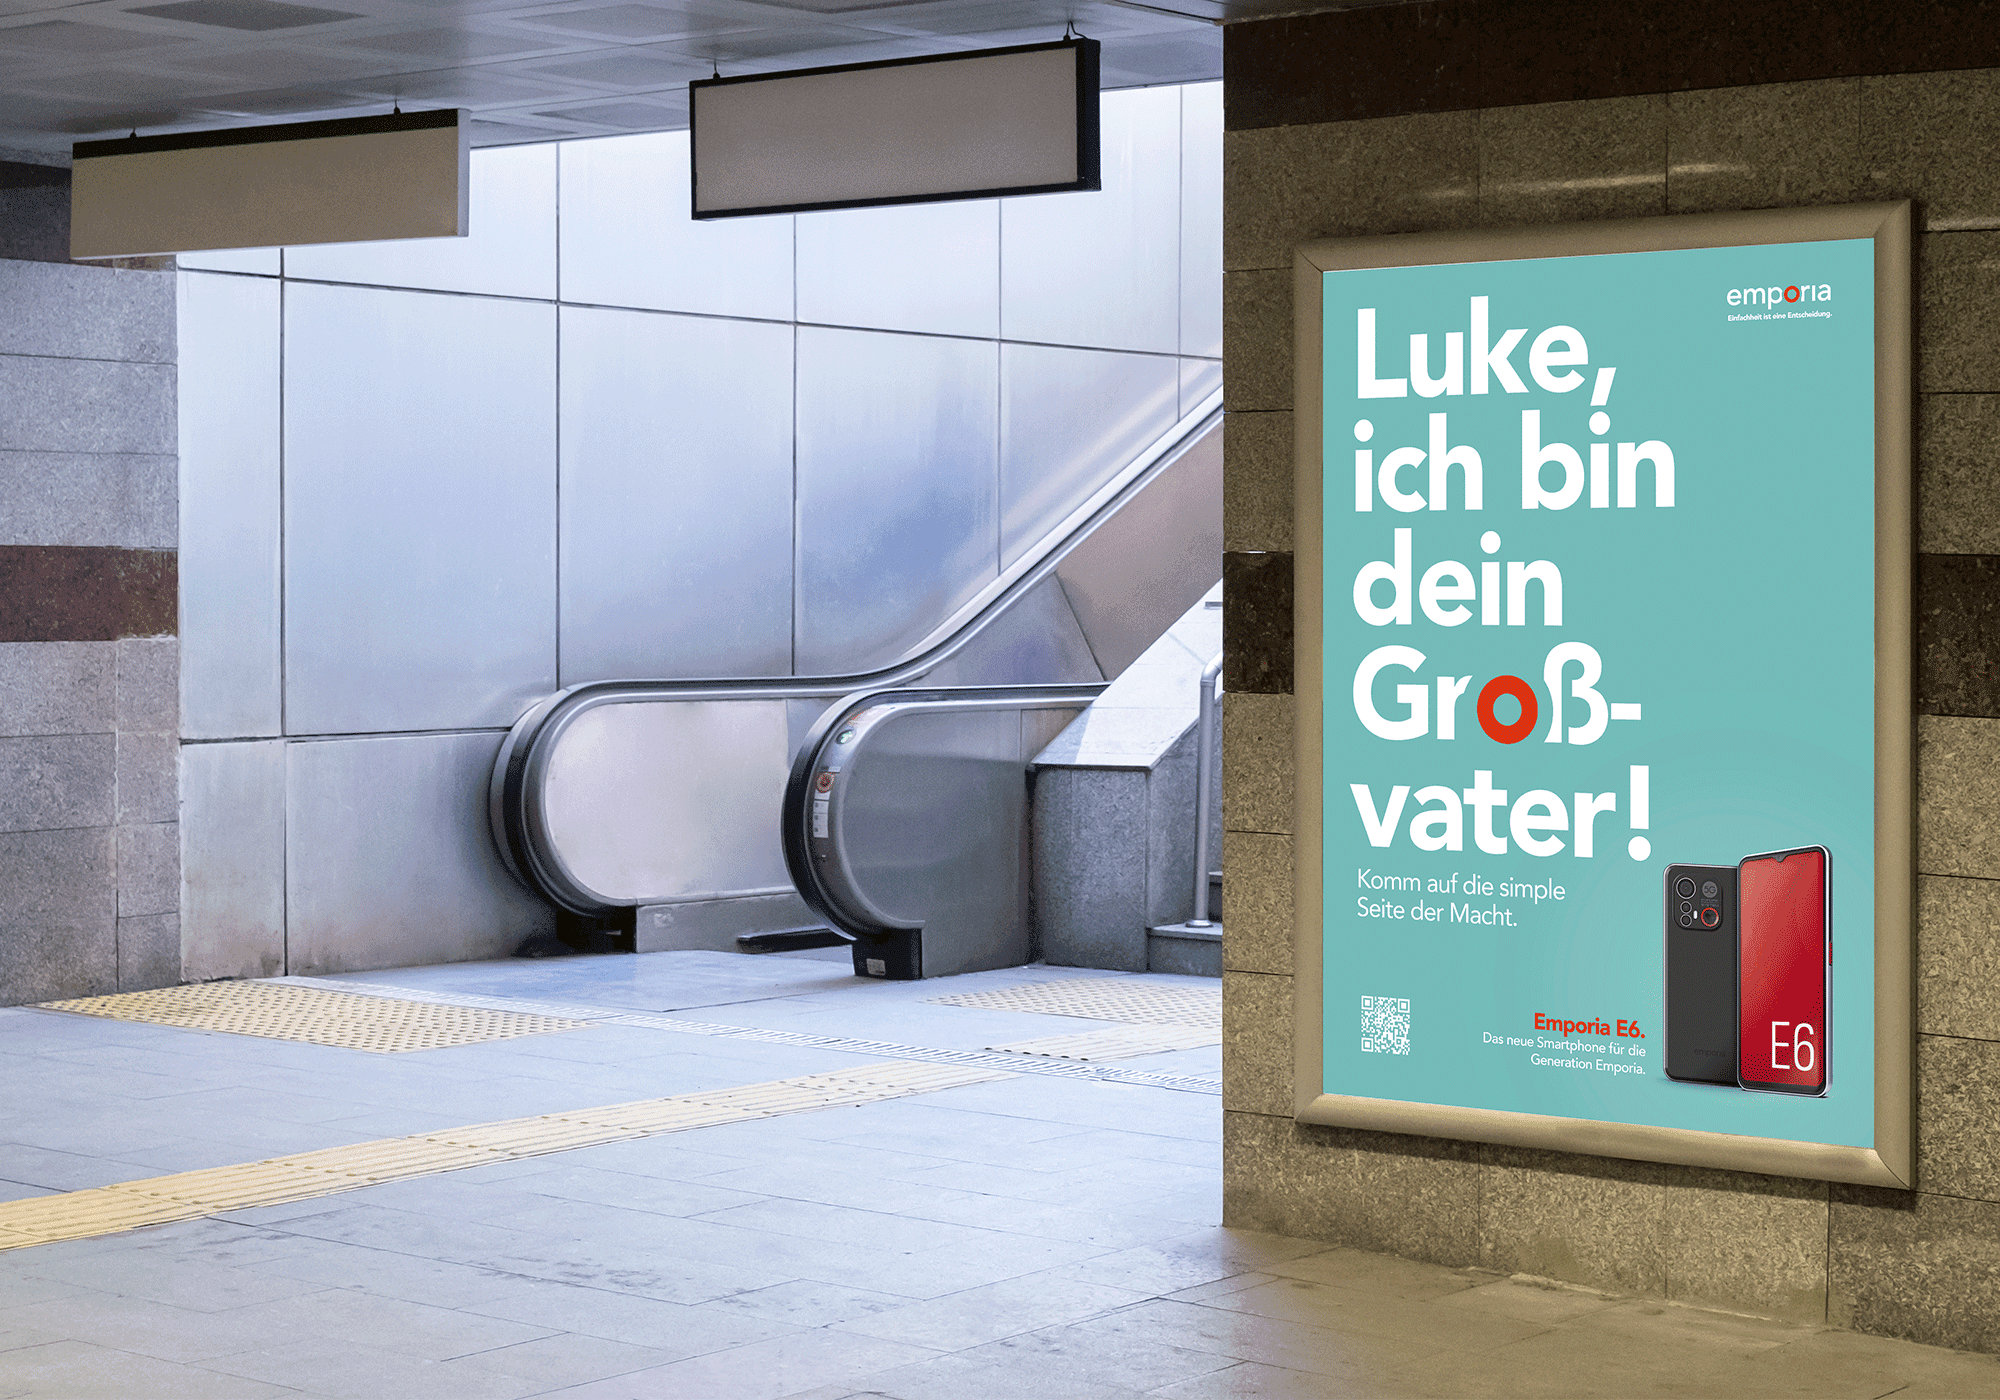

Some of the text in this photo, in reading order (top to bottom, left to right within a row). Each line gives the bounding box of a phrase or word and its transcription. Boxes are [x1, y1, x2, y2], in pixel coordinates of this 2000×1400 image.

[1726, 283, 1832, 310] emporia
[1727, 313, 1763, 322] Einfachheit
[1763, 312, 1772, 321] ist
[1787, 310, 1833, 320] Entscheidung.
[1357, 296, 1617, 406] Luke,
[1353, 410, 1676, 512] ich bin
[1353, 528, 1563, 627] dein
[1353, 642, 1642, 745] Groß-
[1350, 765, 1652, 862] vater!
[1357, 868, 1566, 905] Komm auf die simple
[1357, 896, 1518, 927] Seite der Macht.
[1483, 1031, 1646, 1057] Das neue Smartphone für die
[1534, 1012, 1646, 1039] Emporia E6.
[1530, 1053, 1646, 1076] Generation Emporia.
[1771, 1021, 1815, 1072] E6
